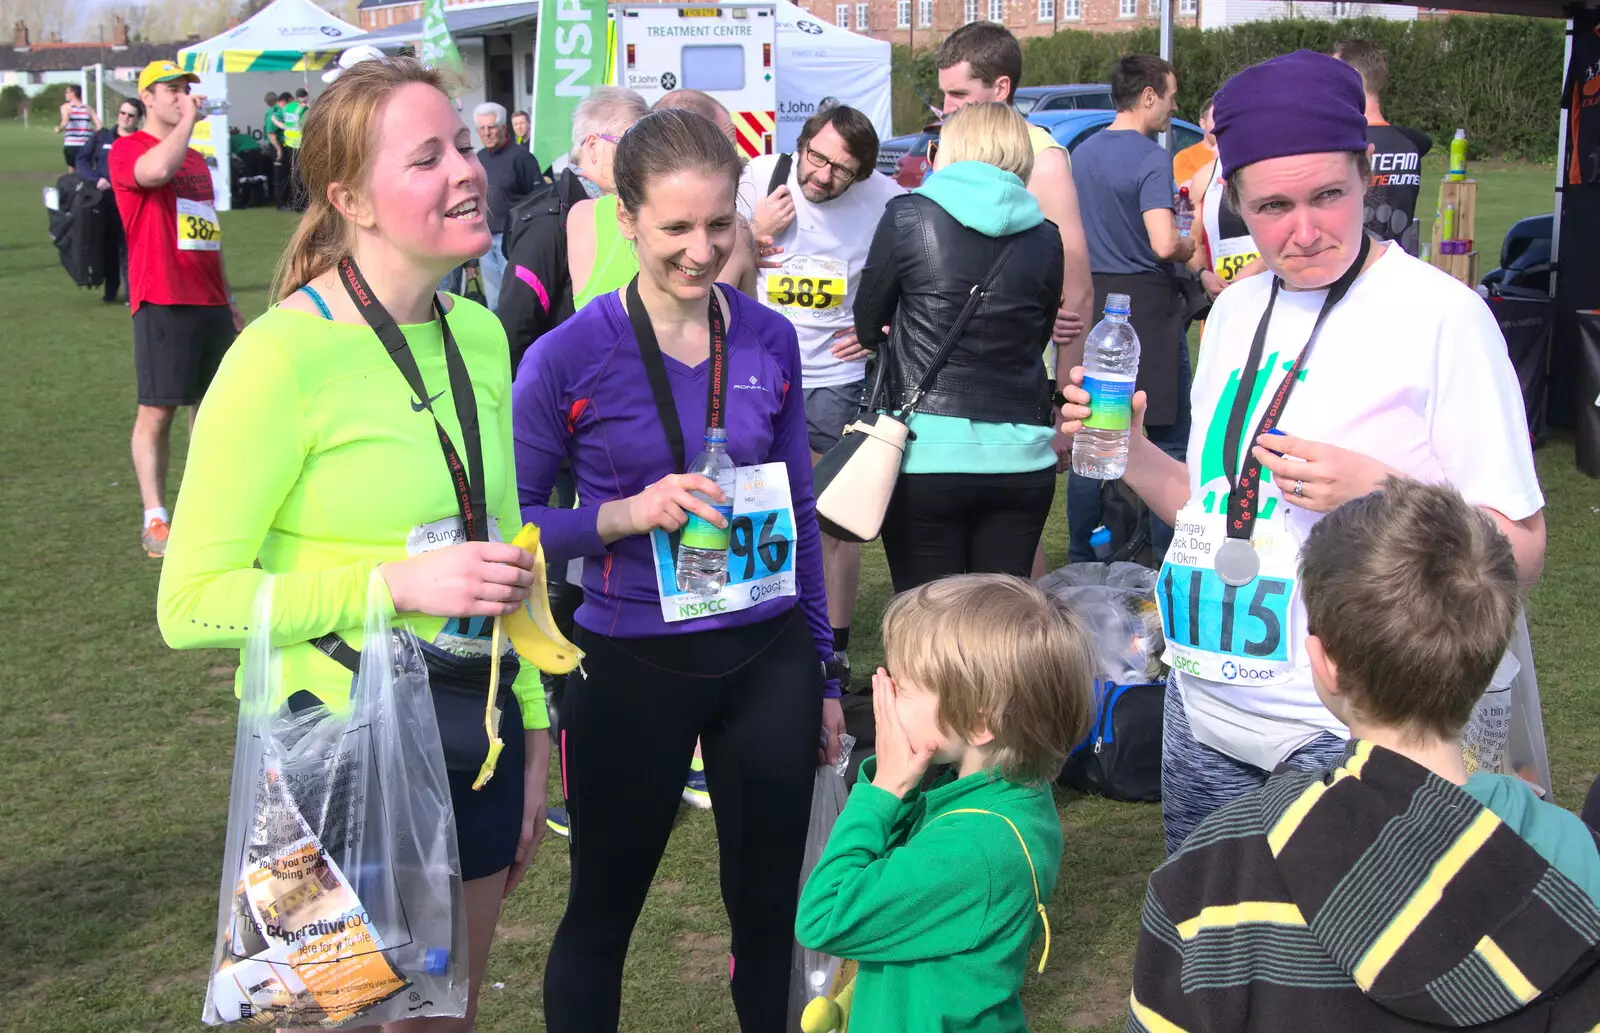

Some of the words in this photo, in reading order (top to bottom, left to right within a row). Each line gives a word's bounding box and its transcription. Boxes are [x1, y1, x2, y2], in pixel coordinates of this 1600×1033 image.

[647, 26, 710, 37] TREATMENT
[713, 26, 752, 36] CENTRE
[628, 75, 638, 84] St
[639, 75, 658, 84] John
[788, 100, 815, 113] John
[1371, 153, 1419, 171] TEAM
[187, 216, 214, 240] 387
[346, 266, 372, 308] FESTIVAL
[777, 277, 832, 309] 385
[713, 354, 723, 395] RUNNING
[713, 397, 720, 409] OF
[1261, 418, 1273, 434] 201
[427, 526, 465, 544] Bungay
[1174, 520, 1206, 536] Bungay
[1190, 538, 1211, 553] Dog
[761, 581, 781, 596] bact
[679, 599, 728, 617] NSPCC
[1164, 566, 1286, 657] 1115
[1238, 666, 1275, 680] bact
